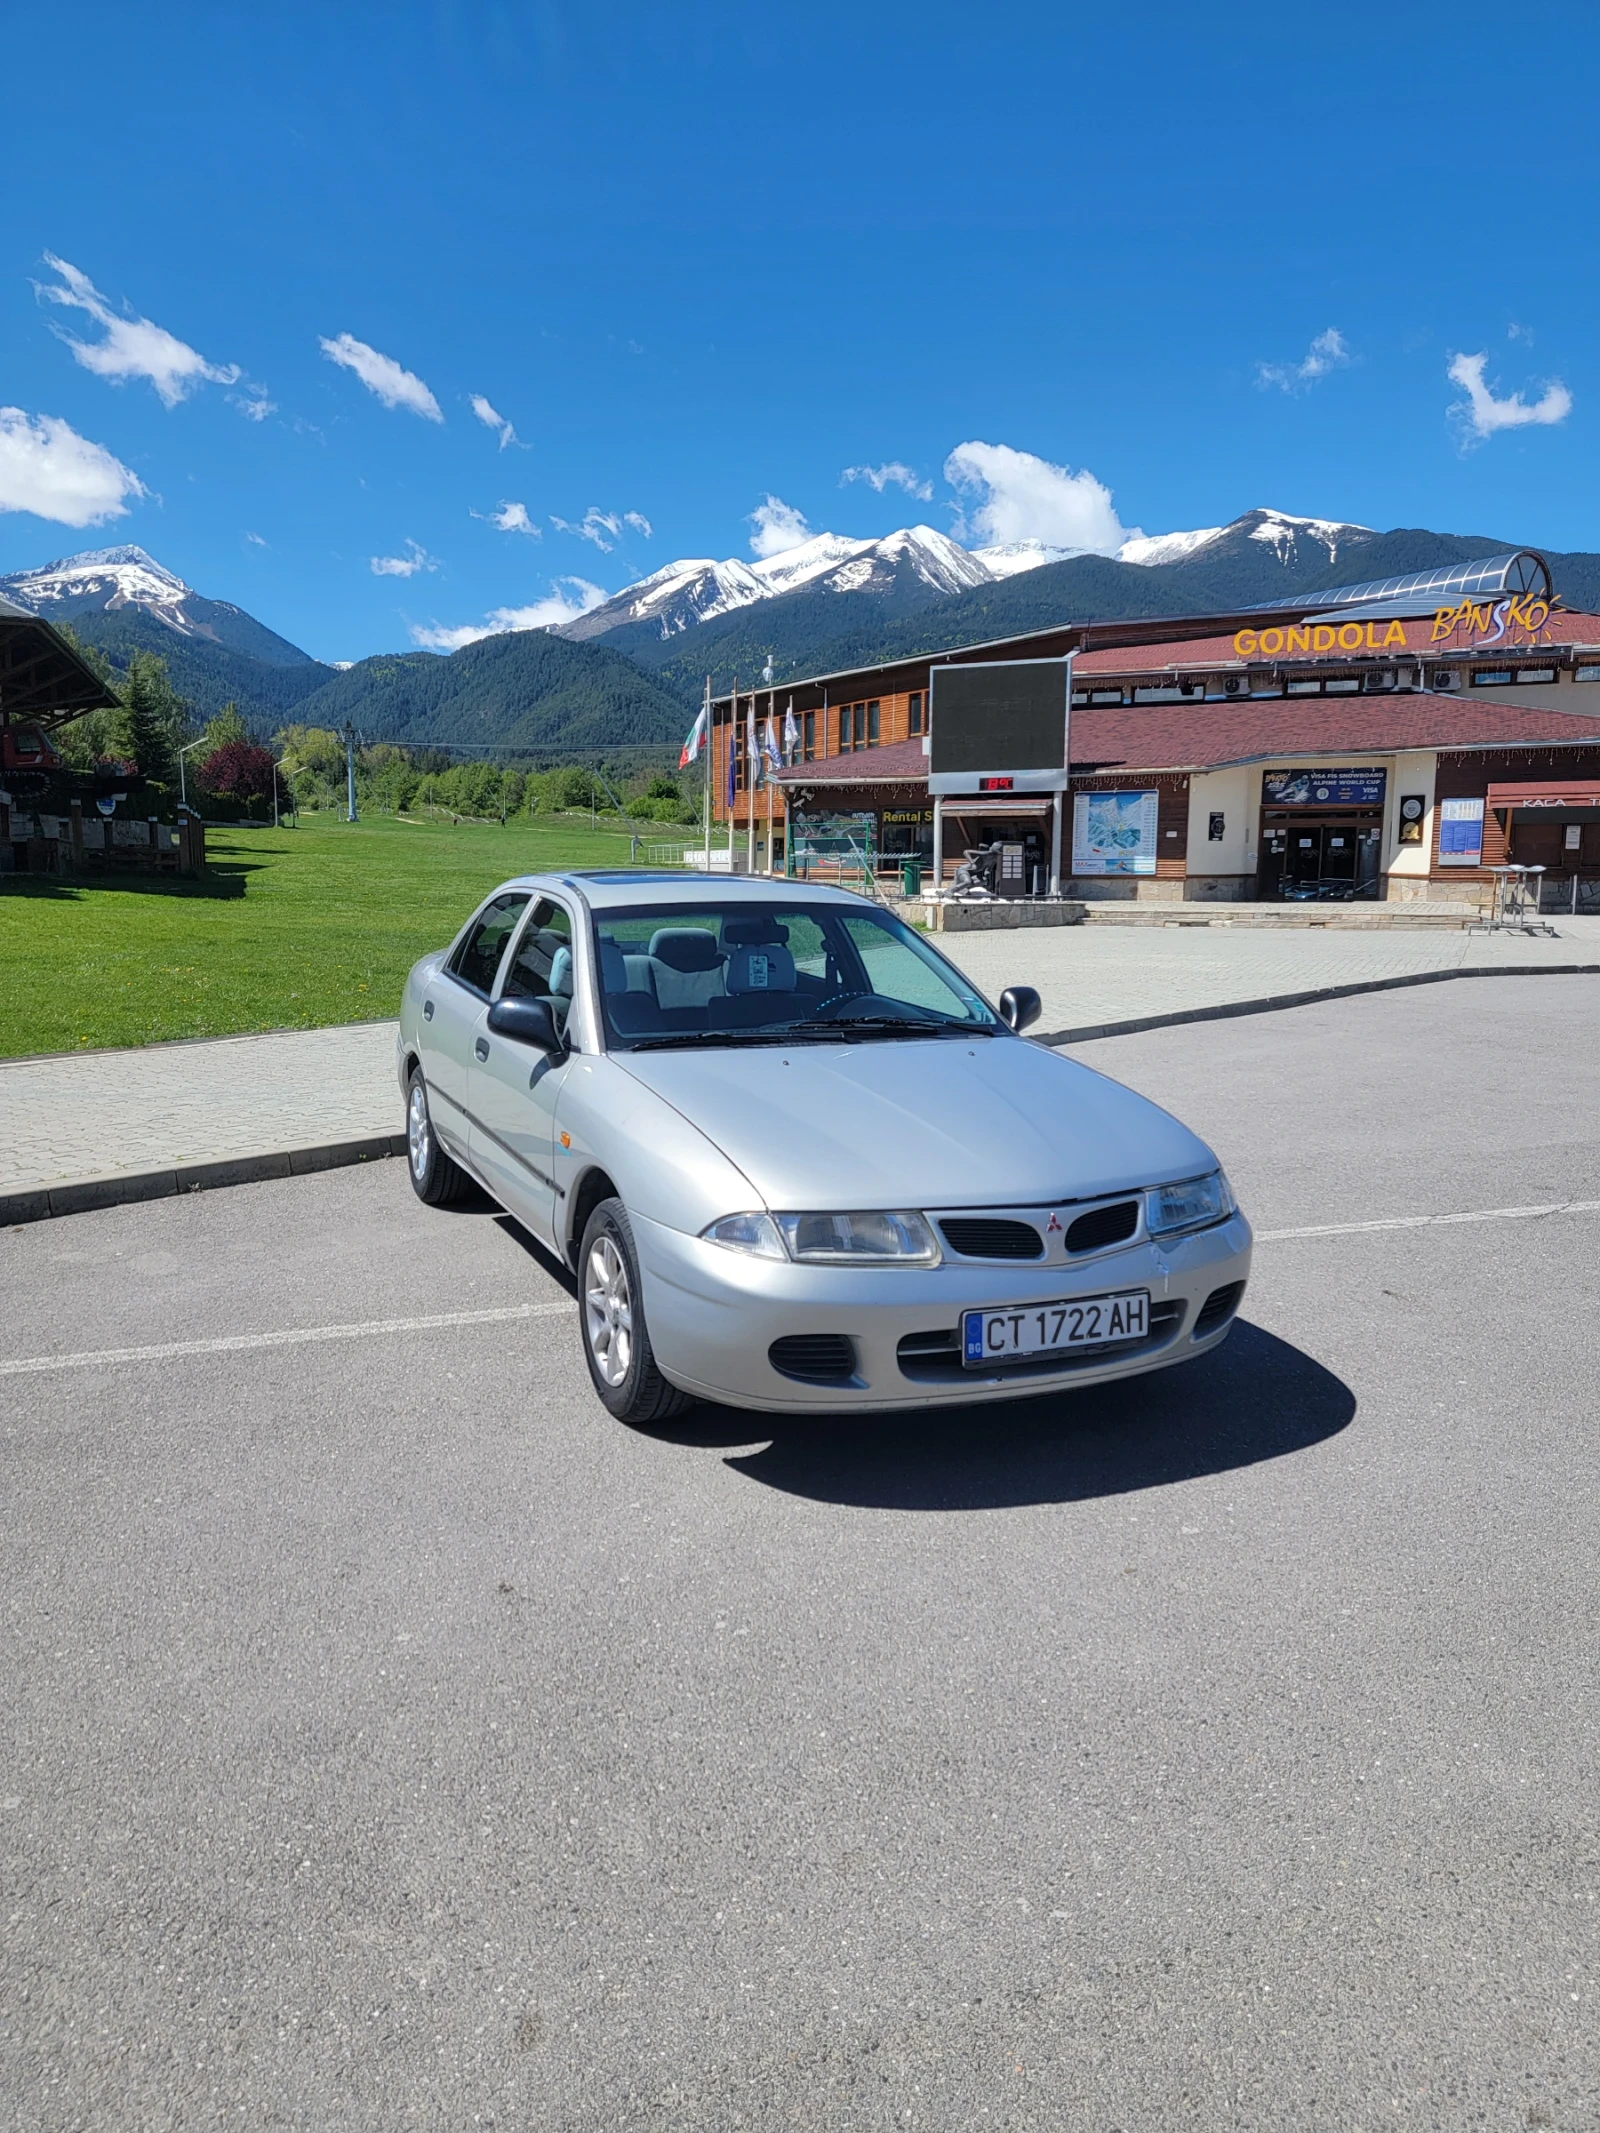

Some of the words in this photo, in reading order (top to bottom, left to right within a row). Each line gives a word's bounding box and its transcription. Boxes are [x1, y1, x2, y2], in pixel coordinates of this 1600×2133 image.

[1233, 620, 1407, 655] GONDOLA
[1430, 592, 1550, 645] BANSKO
[882, 811, 921, 822] Rental
[986, 1314, 1026, 1351] CT
[968, 1342, 981, 1354] BG
